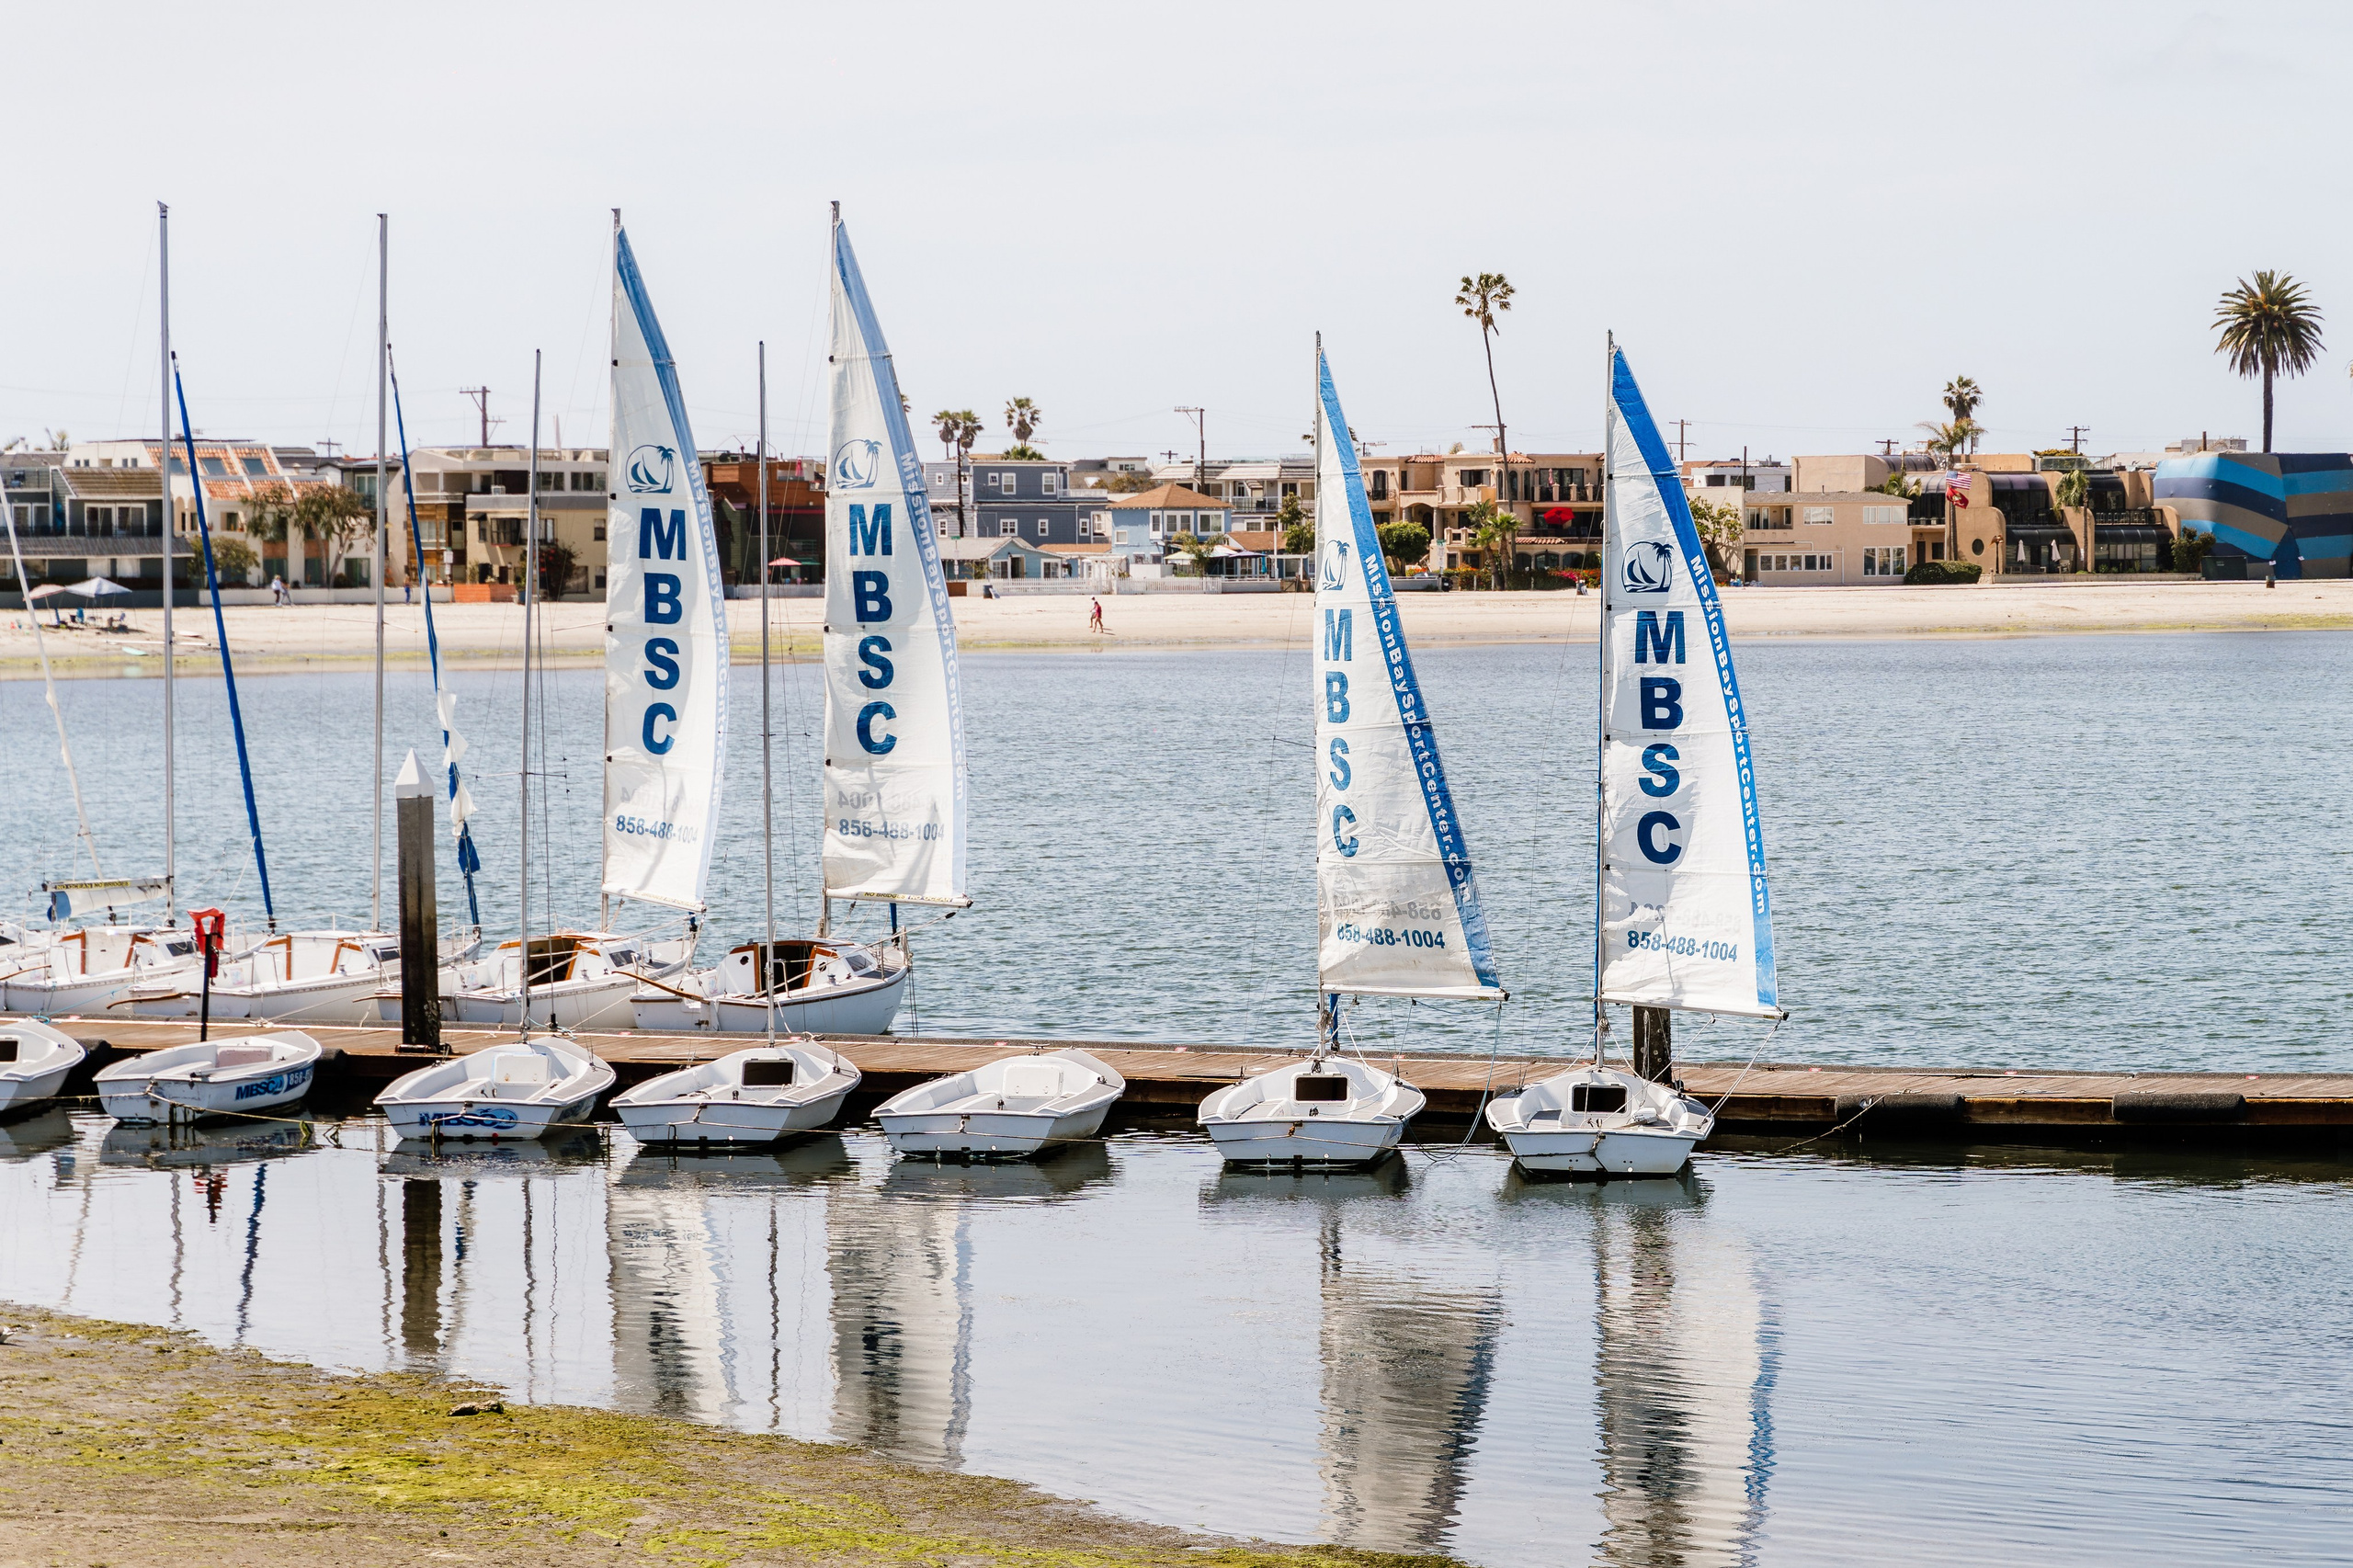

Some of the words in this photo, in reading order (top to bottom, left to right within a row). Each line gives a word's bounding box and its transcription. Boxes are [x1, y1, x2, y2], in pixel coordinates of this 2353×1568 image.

[639, 508, 686, 756] MBSC
[849, 504, 898, 756] MBSC
[1324, 608, 1359, 858] MBSC
[1634, 610, 1686, 864] MBSC
[616, 814, 698, 844] 858-488-1004
[838, 818, 945, 841] 858-488-1004
[1336, 922, 1445, 949] 858-488-1004
[1627, 930, 1738, 962] 858-488-1004
[235, 1080, 277, 1100] MBSC
[419, 1112, 497, 1127] MBSC
